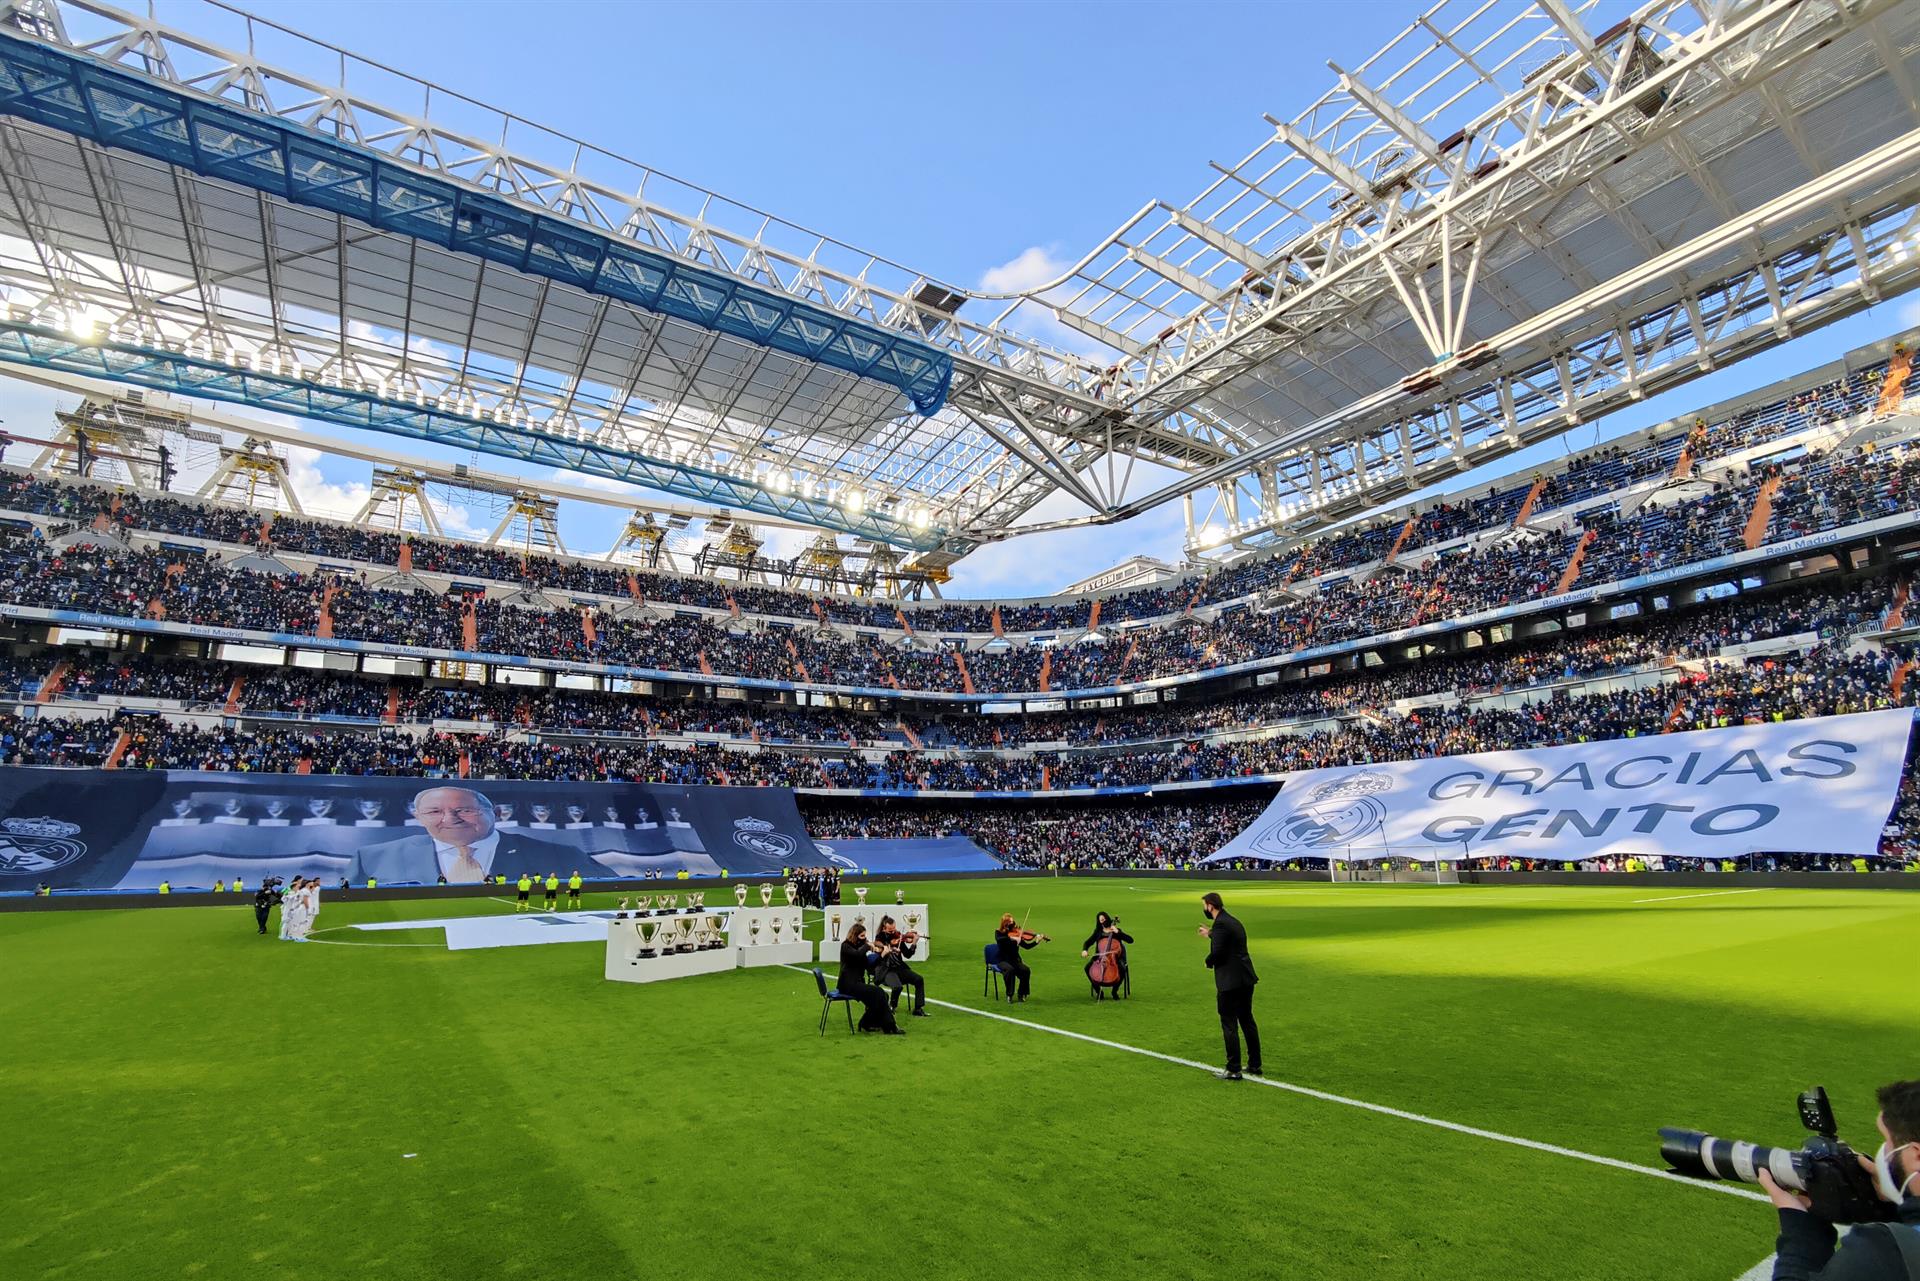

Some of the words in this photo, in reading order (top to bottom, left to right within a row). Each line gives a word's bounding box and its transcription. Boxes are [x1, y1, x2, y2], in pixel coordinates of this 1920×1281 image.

[1766, 543, 1791, 556] Real
[1794, 533, 1838, 548] Madrid
[1646, 571, 1668, 583] Real
[1670, 562, 1703, 577] Madrid
[1542, 597, 1562, 607] Real
[1563, 590, 1593, 602] Madrid
[79, 613, 101, 623] Real
[103, 616, 136, 626] Madrid
[190, 626, 210, 635] Real
[212, 628, 243, 638] Madrid
[292, 636, 311, 644] Real
[313, 638, 340, 647] Madrid
[1375, 635, 1390, 643] Real
[384, 645, 402, 653] Real
[403, 647, 429, 656] Madrid
[488, 654, 511, 663] Madrid
[1428, 739, 1857, 801] GRACIAS
[1421, 802, 1780, 843] GENTO
